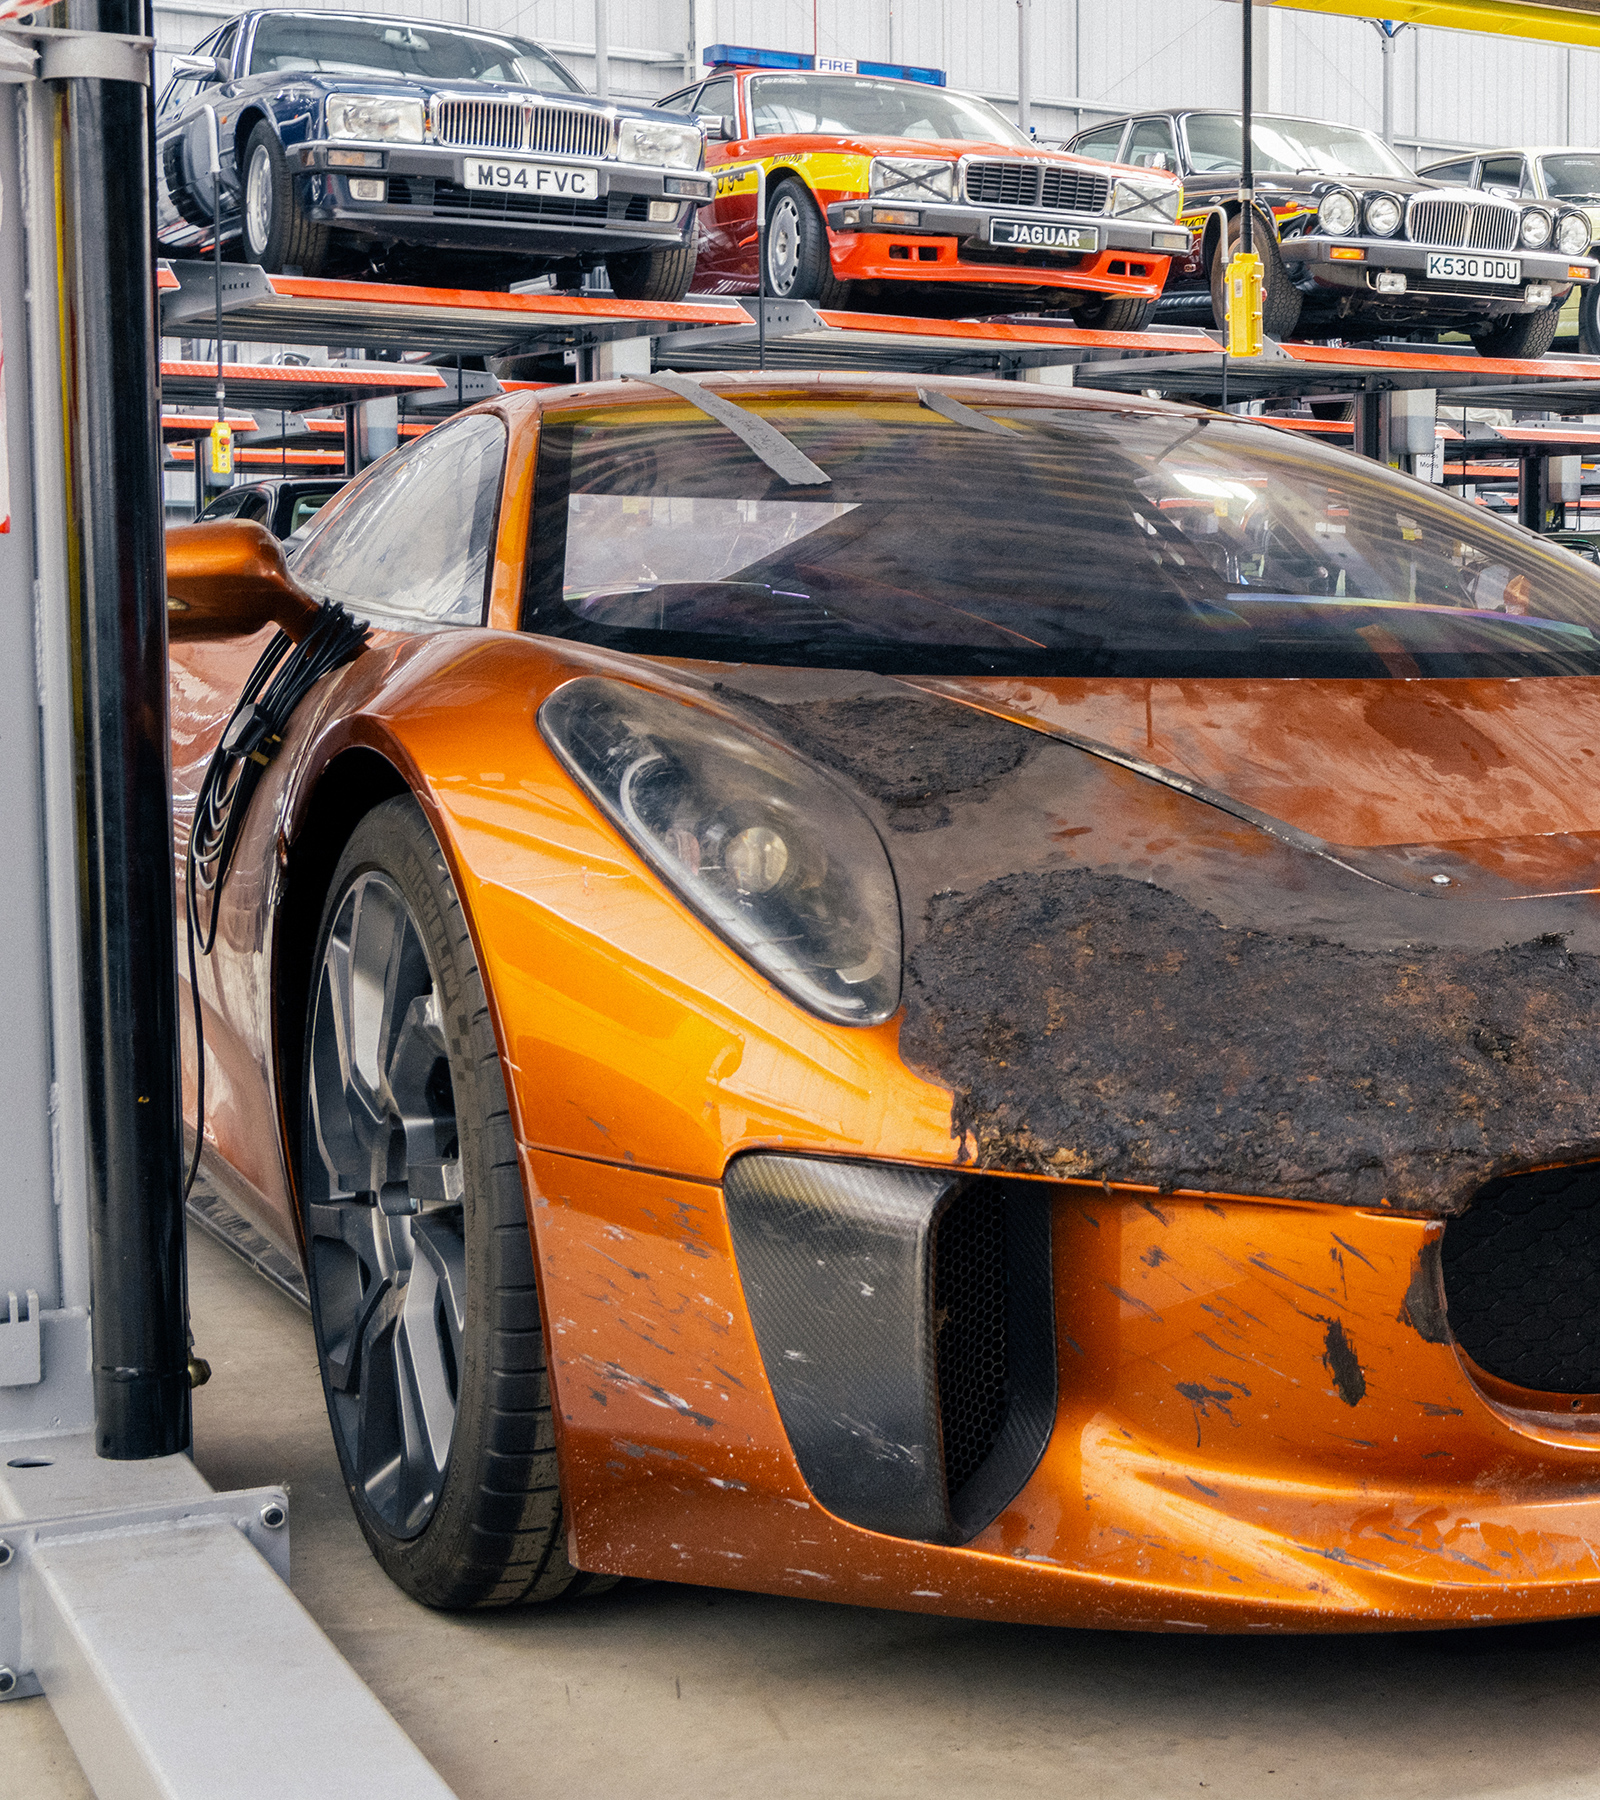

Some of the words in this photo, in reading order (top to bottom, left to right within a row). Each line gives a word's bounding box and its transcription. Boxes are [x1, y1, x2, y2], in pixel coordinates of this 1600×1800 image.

[819, 58, 854, 73] FIRE
[478, 164, 528, 188] M94
[537, 169, 585, 193] FVC
[1007, 224, 1080, 247] JAGUAR
[1430, 256, 1478, 277] K530
[1484, 260, 1517, 280] DDU
[404, 851, 461, 1000] MICHELIN
